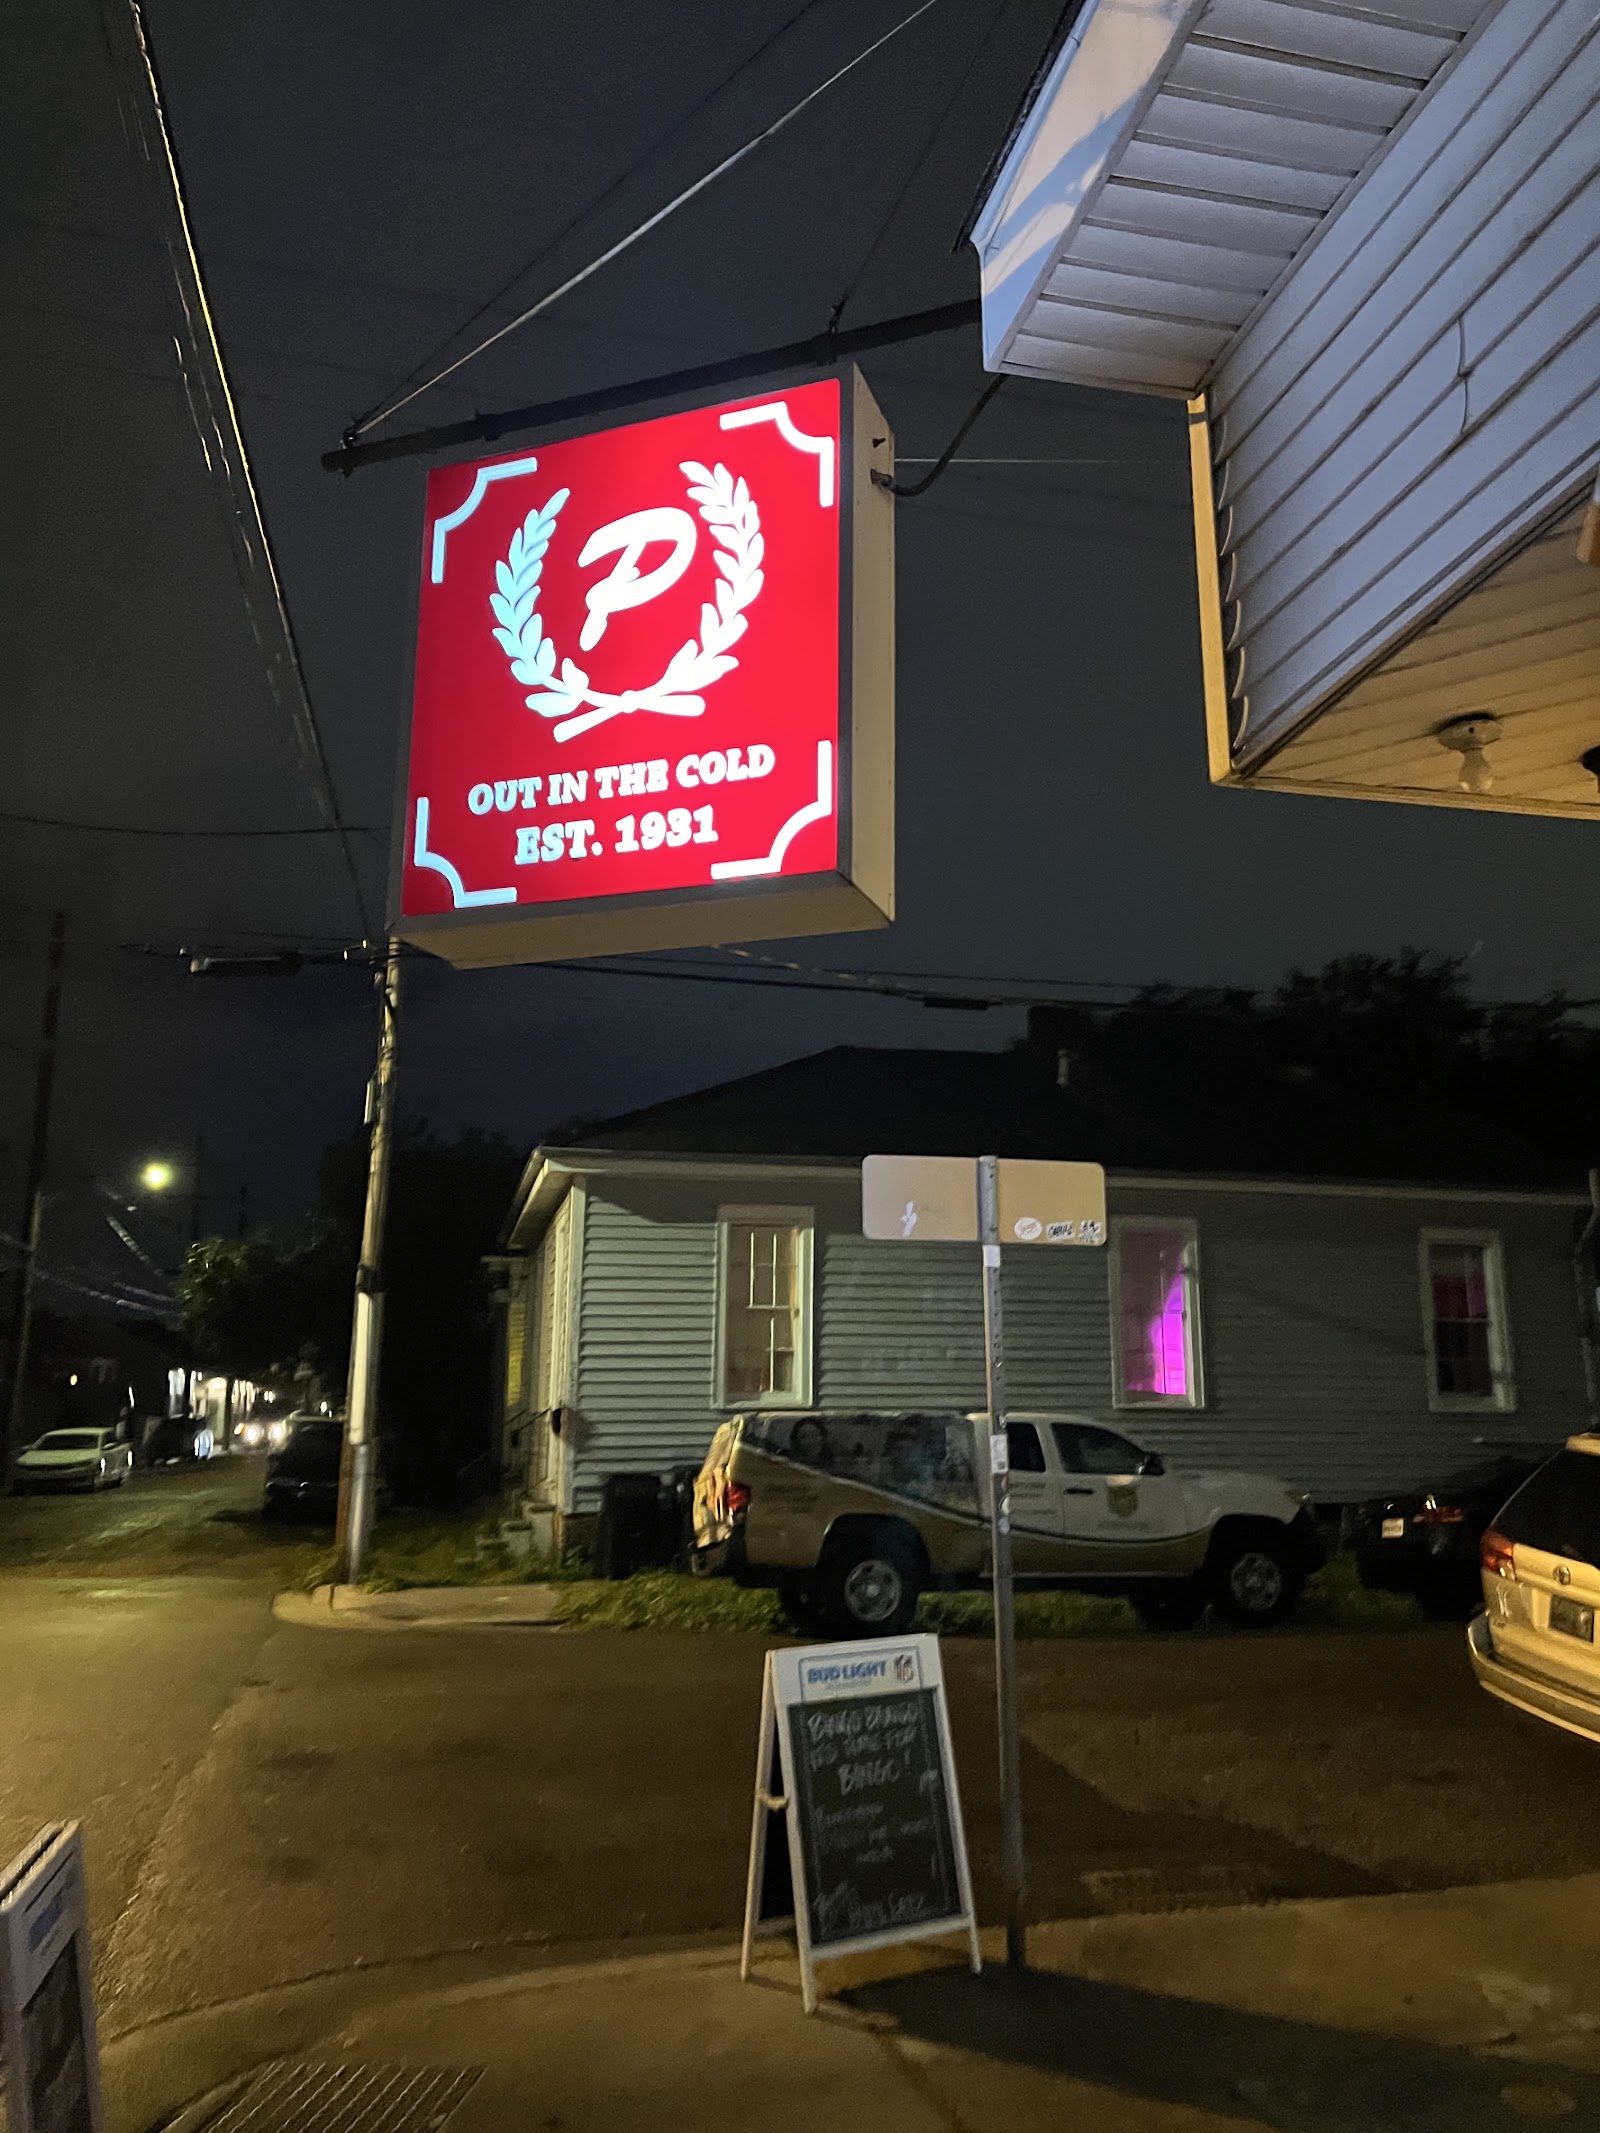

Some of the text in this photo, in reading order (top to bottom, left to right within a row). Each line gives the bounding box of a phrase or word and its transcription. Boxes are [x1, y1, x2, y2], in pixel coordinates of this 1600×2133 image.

[577, 507, 697, 651] P
[467, 744, 775, 815] OUT IN THE COLD
[514, 803, 719, 866] EST. 1931
[807, 1665, 841, 1684] BUD
[842, 1659, 887, 1680] LIGHT
